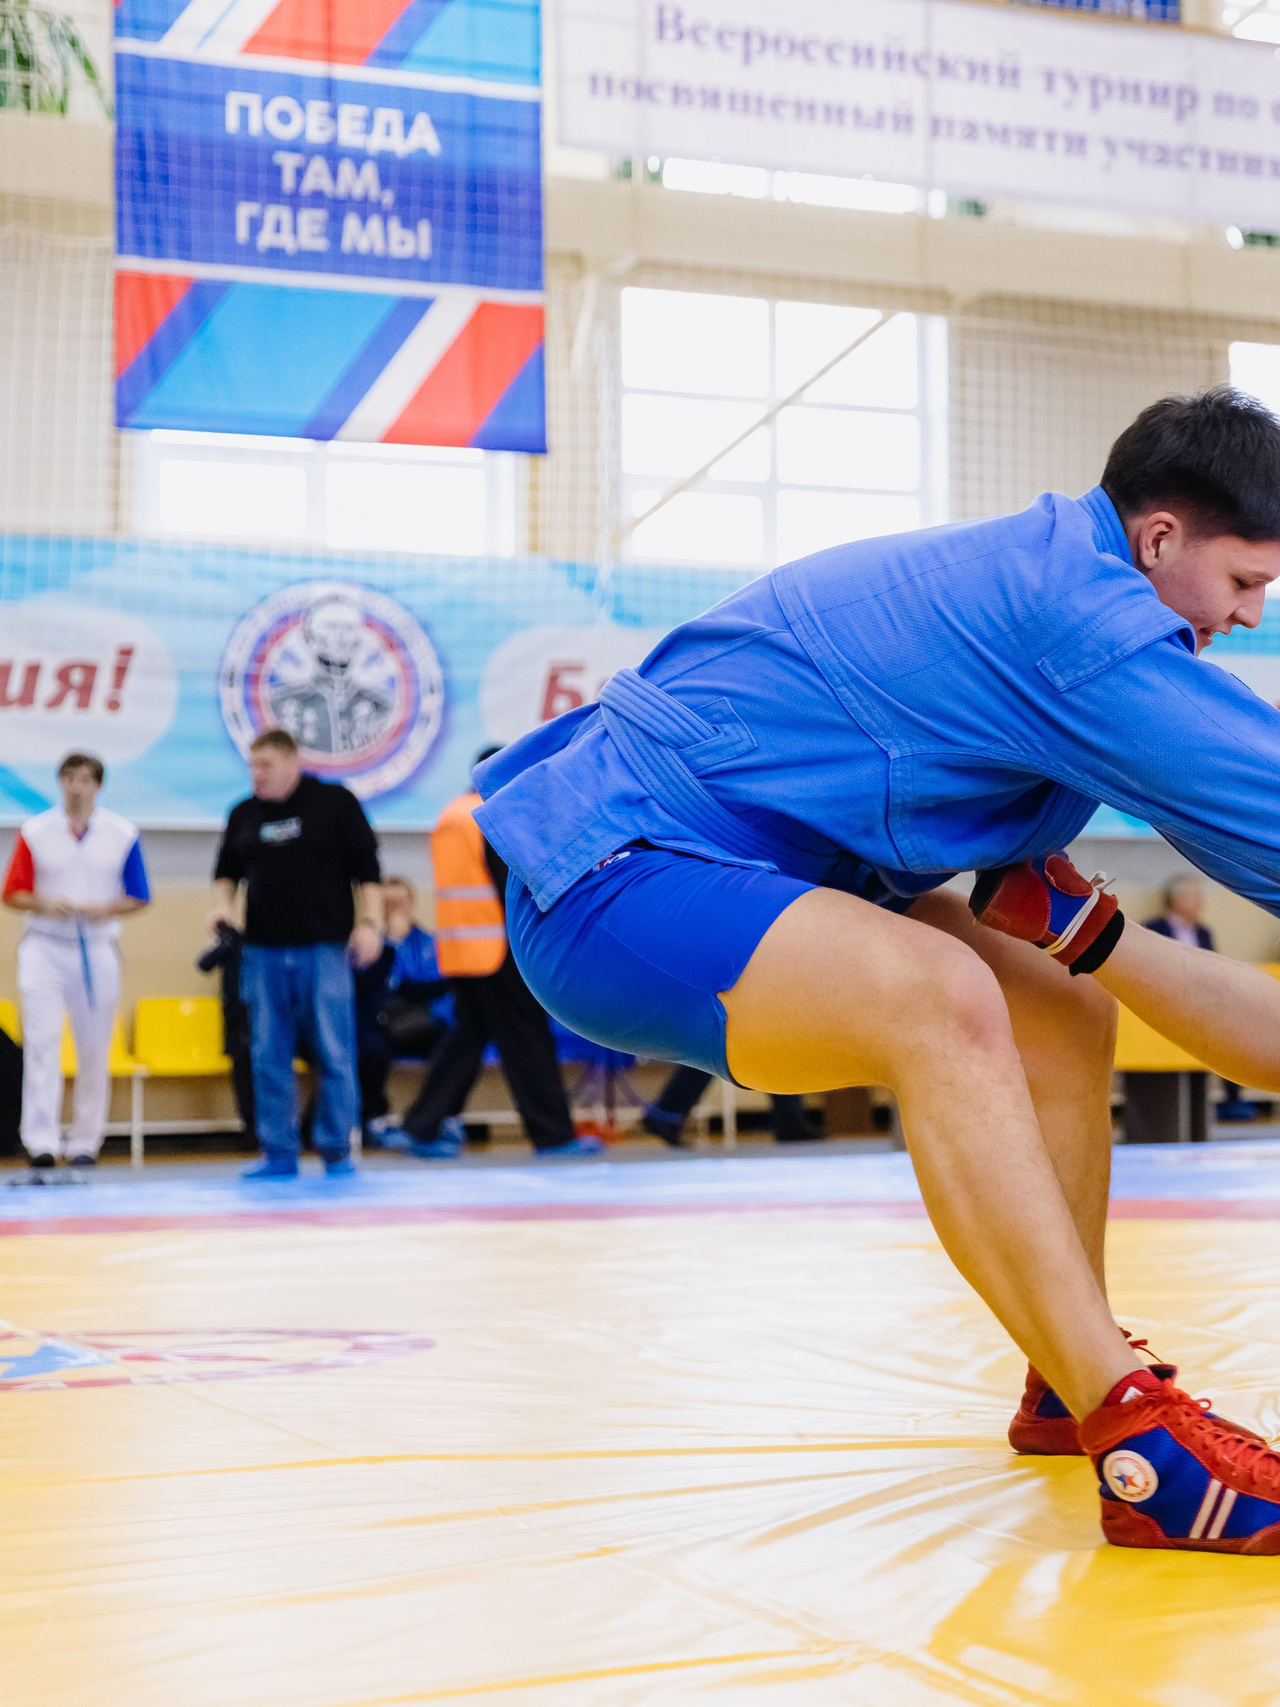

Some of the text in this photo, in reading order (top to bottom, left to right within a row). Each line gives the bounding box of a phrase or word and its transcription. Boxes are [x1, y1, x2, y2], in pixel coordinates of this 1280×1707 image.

[653, 1, 1021, 89] Всероссийский
[1041, 66, 1200, 122] турнир
[1212, 90, 1260, 118] по
[224, 90, 441, 156] ПОБЕДА
[587, 68, 915, 135] посвященный
[928, 112, 1088, 157] памяти
[273, 151, 395, 208] ТАМ,
[236, 201, 432, 261] ГДЕ МЫ
